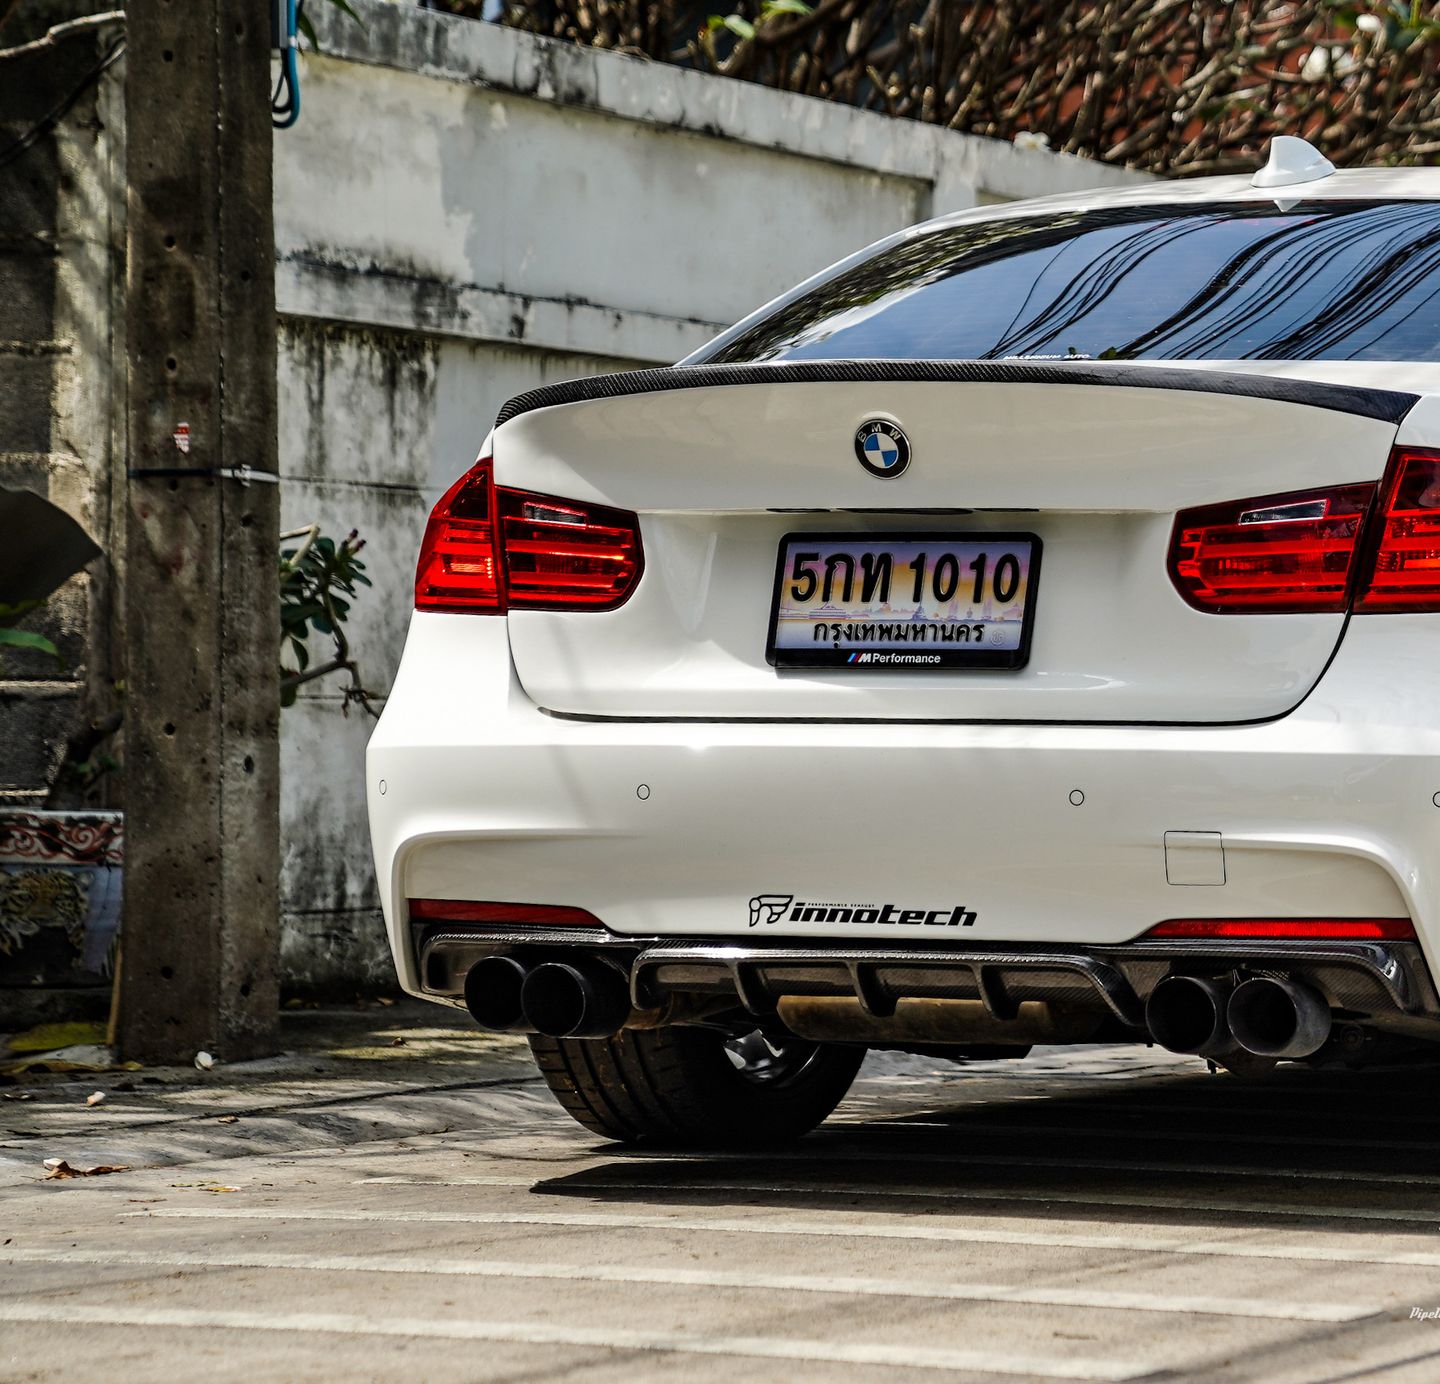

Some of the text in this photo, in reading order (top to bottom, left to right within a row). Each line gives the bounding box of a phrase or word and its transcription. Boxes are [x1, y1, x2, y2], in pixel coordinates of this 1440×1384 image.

[857, 423, 901, 443] BMW
[909, 552, 1020, 603] 1010
[813, 622, 985, 648] กรุงเทพมหานคร
[789, 902, 977, 926] innotech
